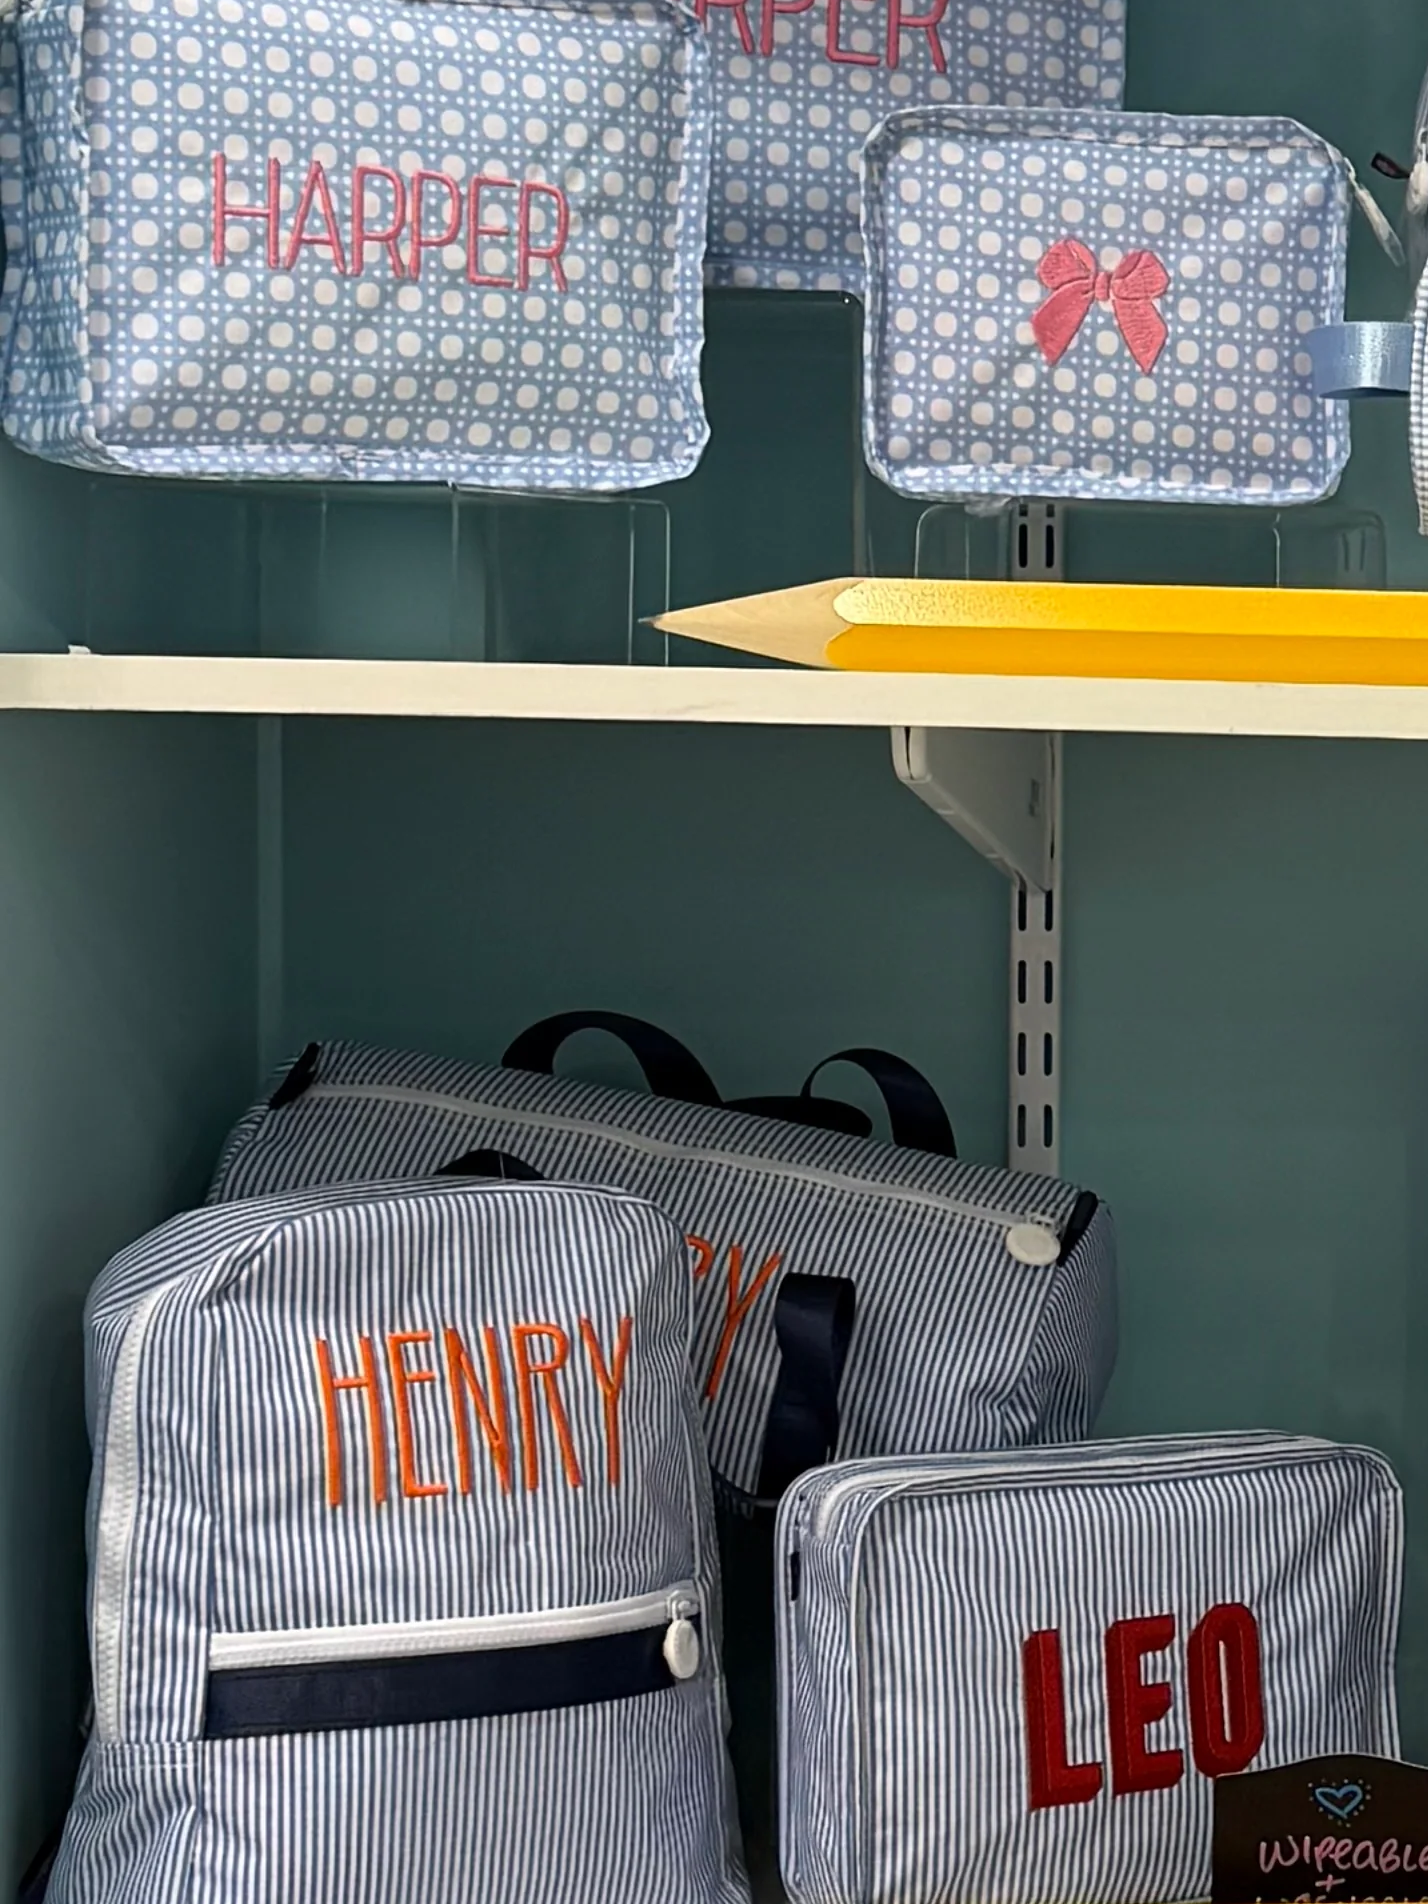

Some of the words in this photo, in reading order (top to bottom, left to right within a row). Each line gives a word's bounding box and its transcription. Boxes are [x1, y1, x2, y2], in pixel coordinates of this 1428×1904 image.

[212, 151, 570, 292] HARPER
[314, 1313, 633, 1508] HENRY
[1021, 1601, 1264, 1812] LEO
